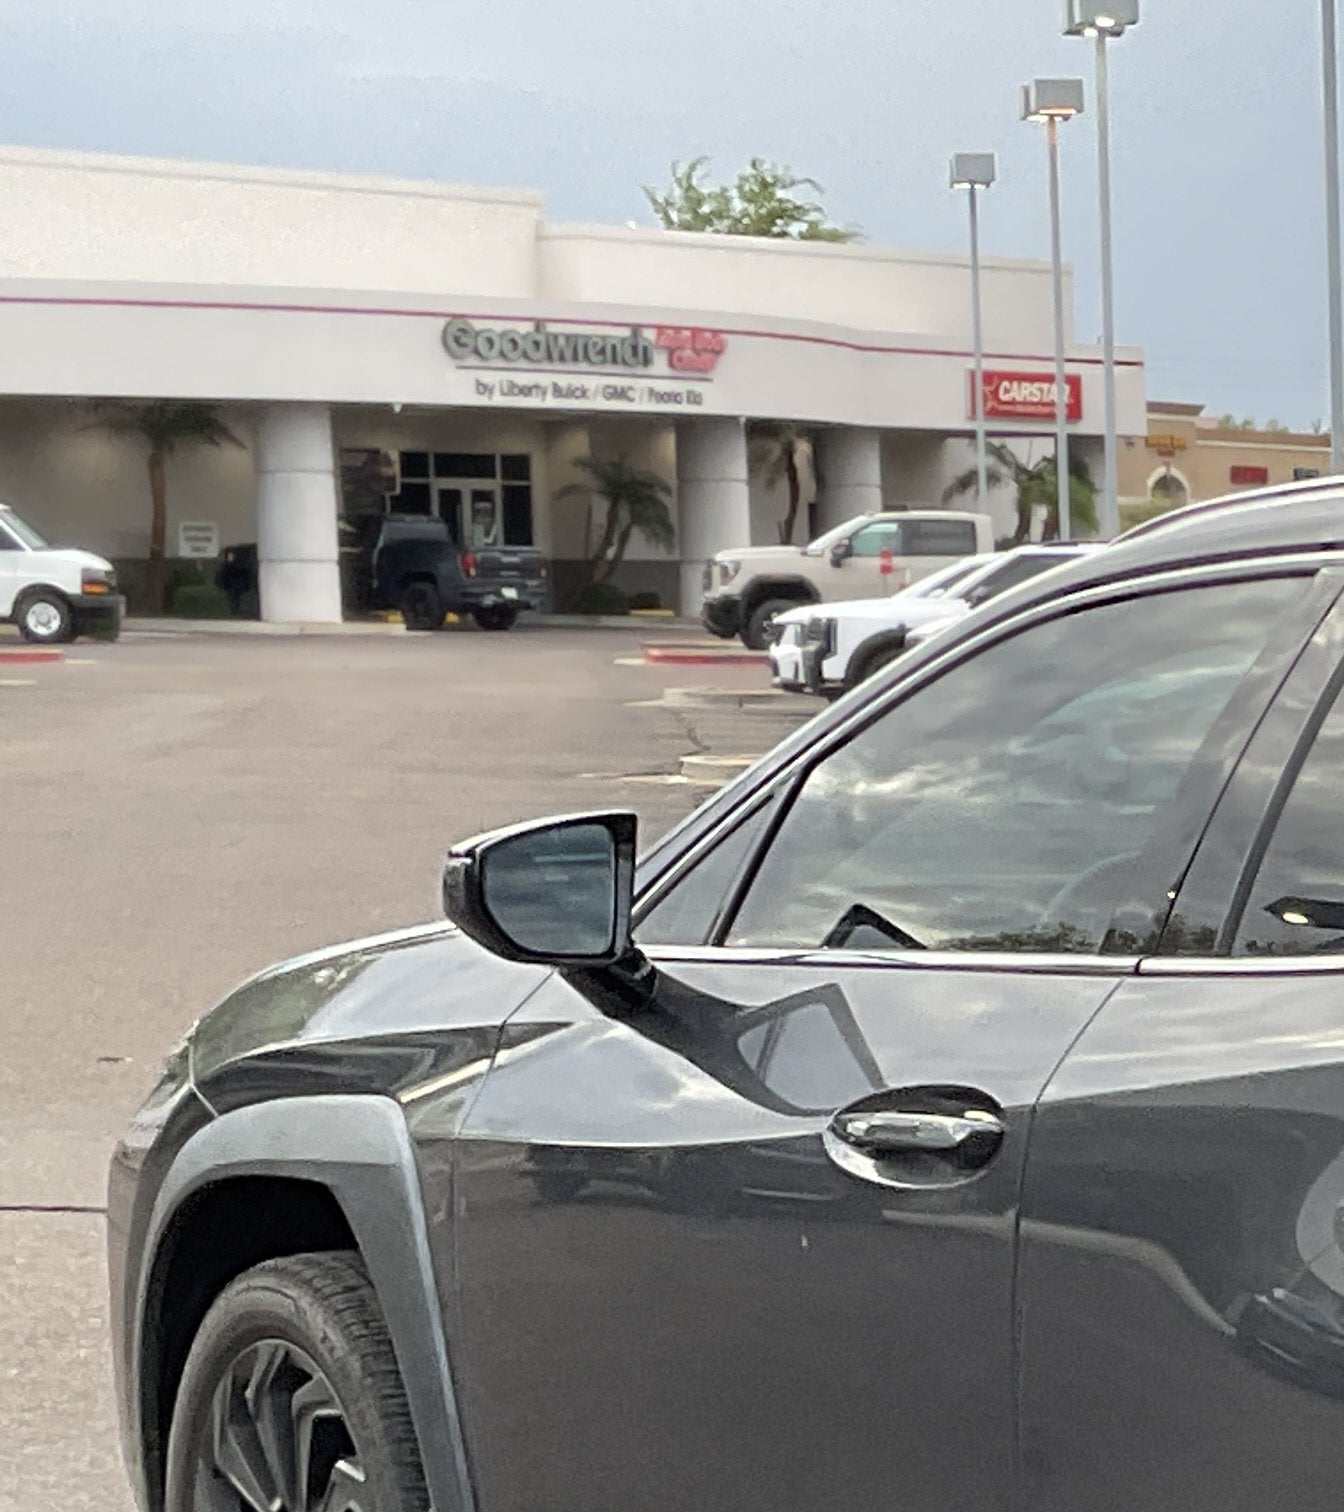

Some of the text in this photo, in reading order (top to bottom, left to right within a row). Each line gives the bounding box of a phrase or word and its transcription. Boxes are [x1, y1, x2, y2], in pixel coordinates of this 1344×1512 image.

[442, 318, 655, 368] Goodwrench
[475, 379, 495, 401] by
[498, 379, 549, 402] Liberty
[998, 380, 1071, 405] CARSTA
